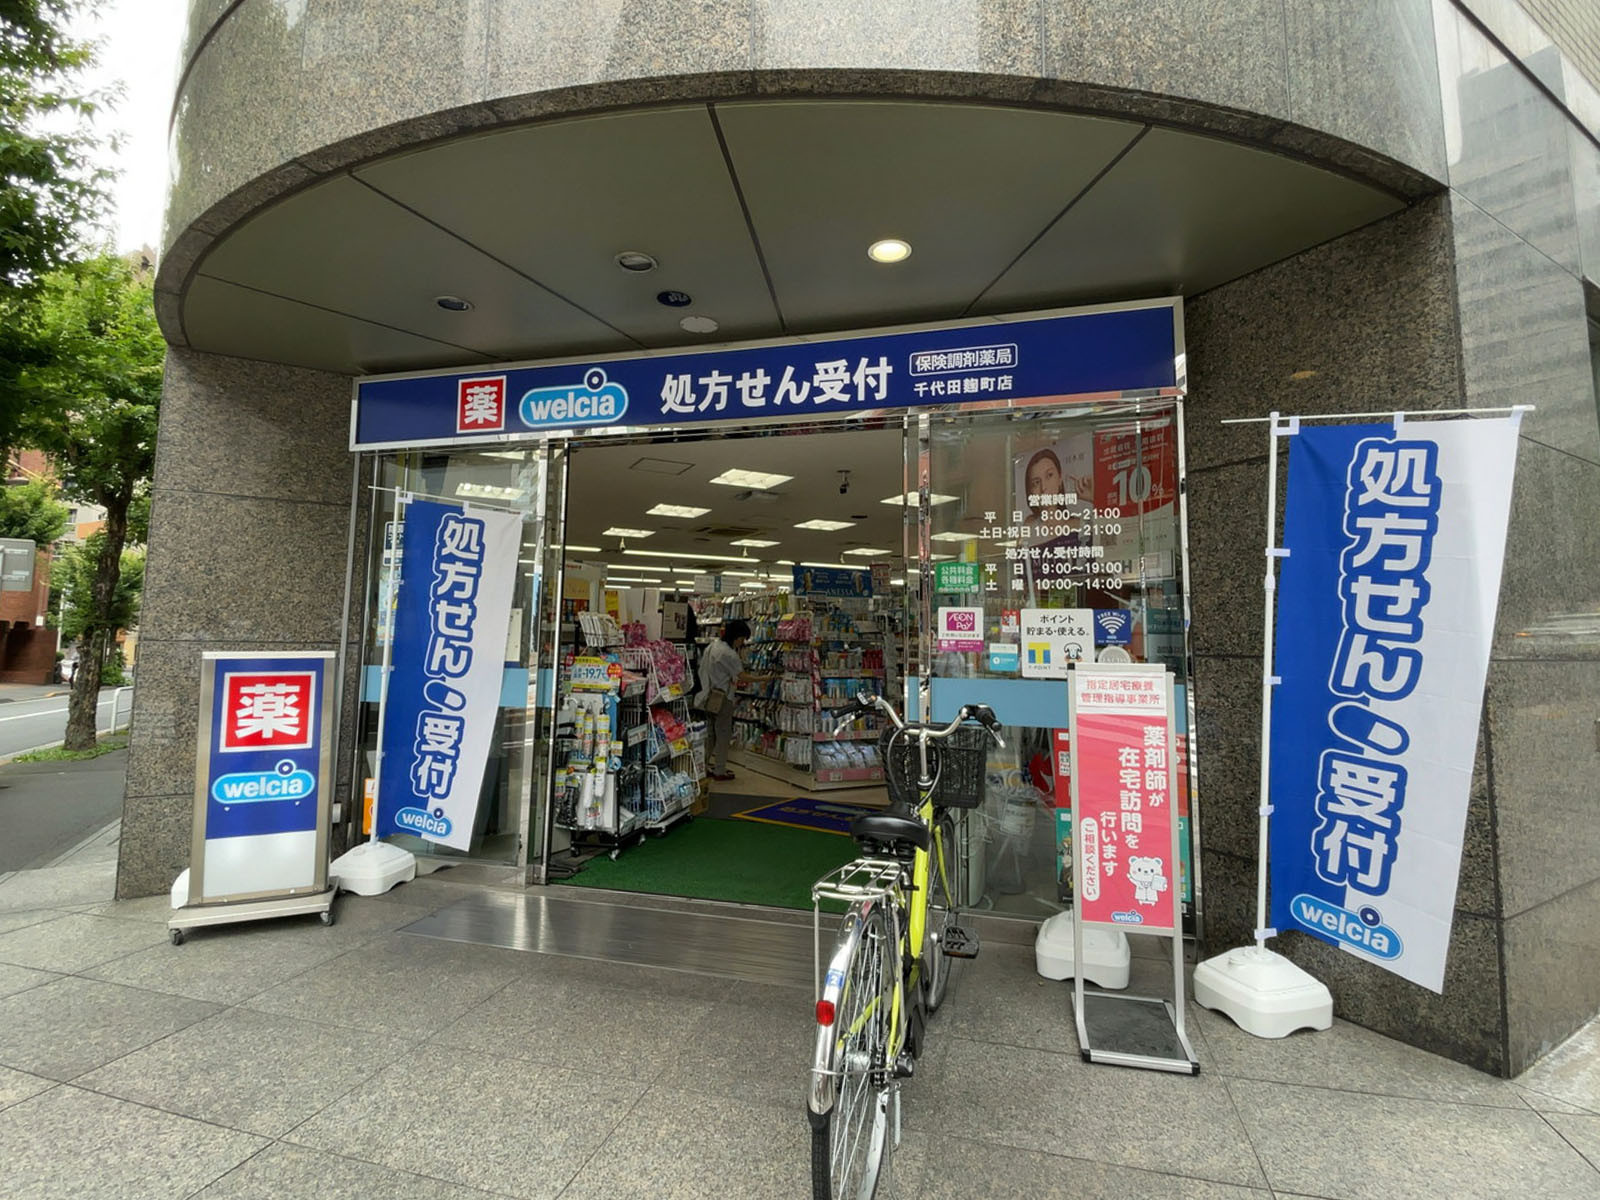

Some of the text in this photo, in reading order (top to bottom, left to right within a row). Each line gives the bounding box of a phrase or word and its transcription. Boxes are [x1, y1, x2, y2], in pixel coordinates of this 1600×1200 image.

[915, 349, 1012, 372] 保険調剤薬局
[659, 356, 893, 415] 処方せん受付
[464, 385, 498, 425] 薬
[529, 392, 615, 421] welcia
[1028, 493, 1078, 507] 営業時間
[1005, 546, 1104, 560] 処方せん受付時間
[1039, 614, 1075, 624] ポイント
[234, 682, 301, 739] 薬
[1081, 692, 1160, 705] 管理指導事業所
[1143, 725, 1168, 808] 薬剤師が
[223, 775, 303, 799] welcia
[1118, 747, 1143, 850] 在宅訪問を
[402, 812, 447, 835] welcia
[1099, 811, 1118, 877] 行います
[1298, 900, 1391, 955] welcia
